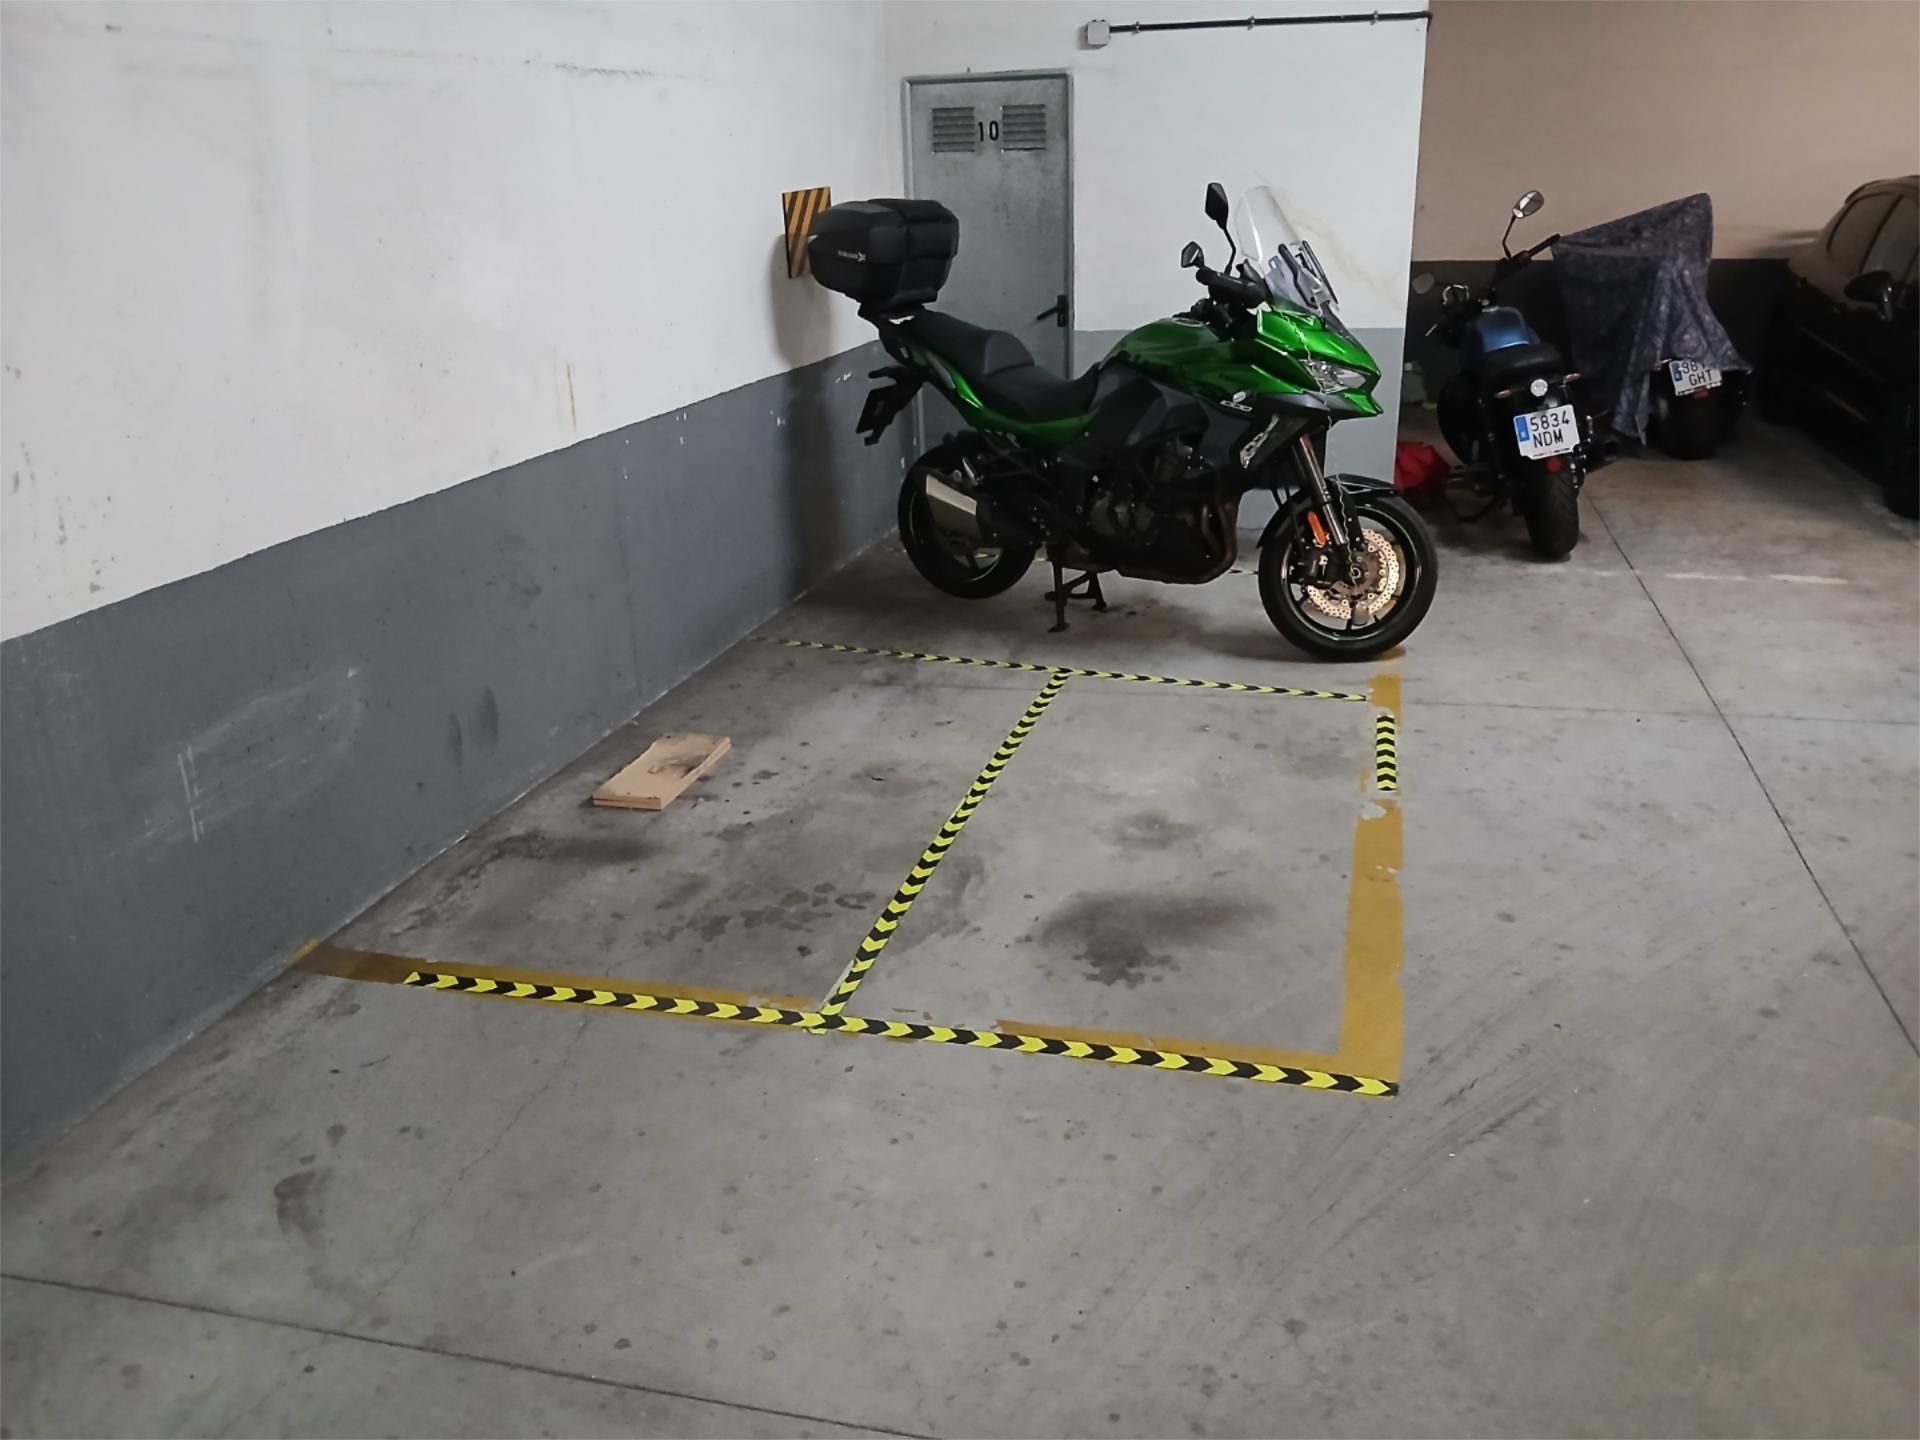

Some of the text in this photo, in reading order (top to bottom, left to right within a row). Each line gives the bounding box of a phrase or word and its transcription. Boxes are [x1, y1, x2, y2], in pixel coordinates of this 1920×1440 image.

[978, 121, 999, 141] 10
[1689, 369, 1712, 386] GHT
[1530, 410, 1570, 431] 5834
[1532, 428, 1564, 448] NDM
